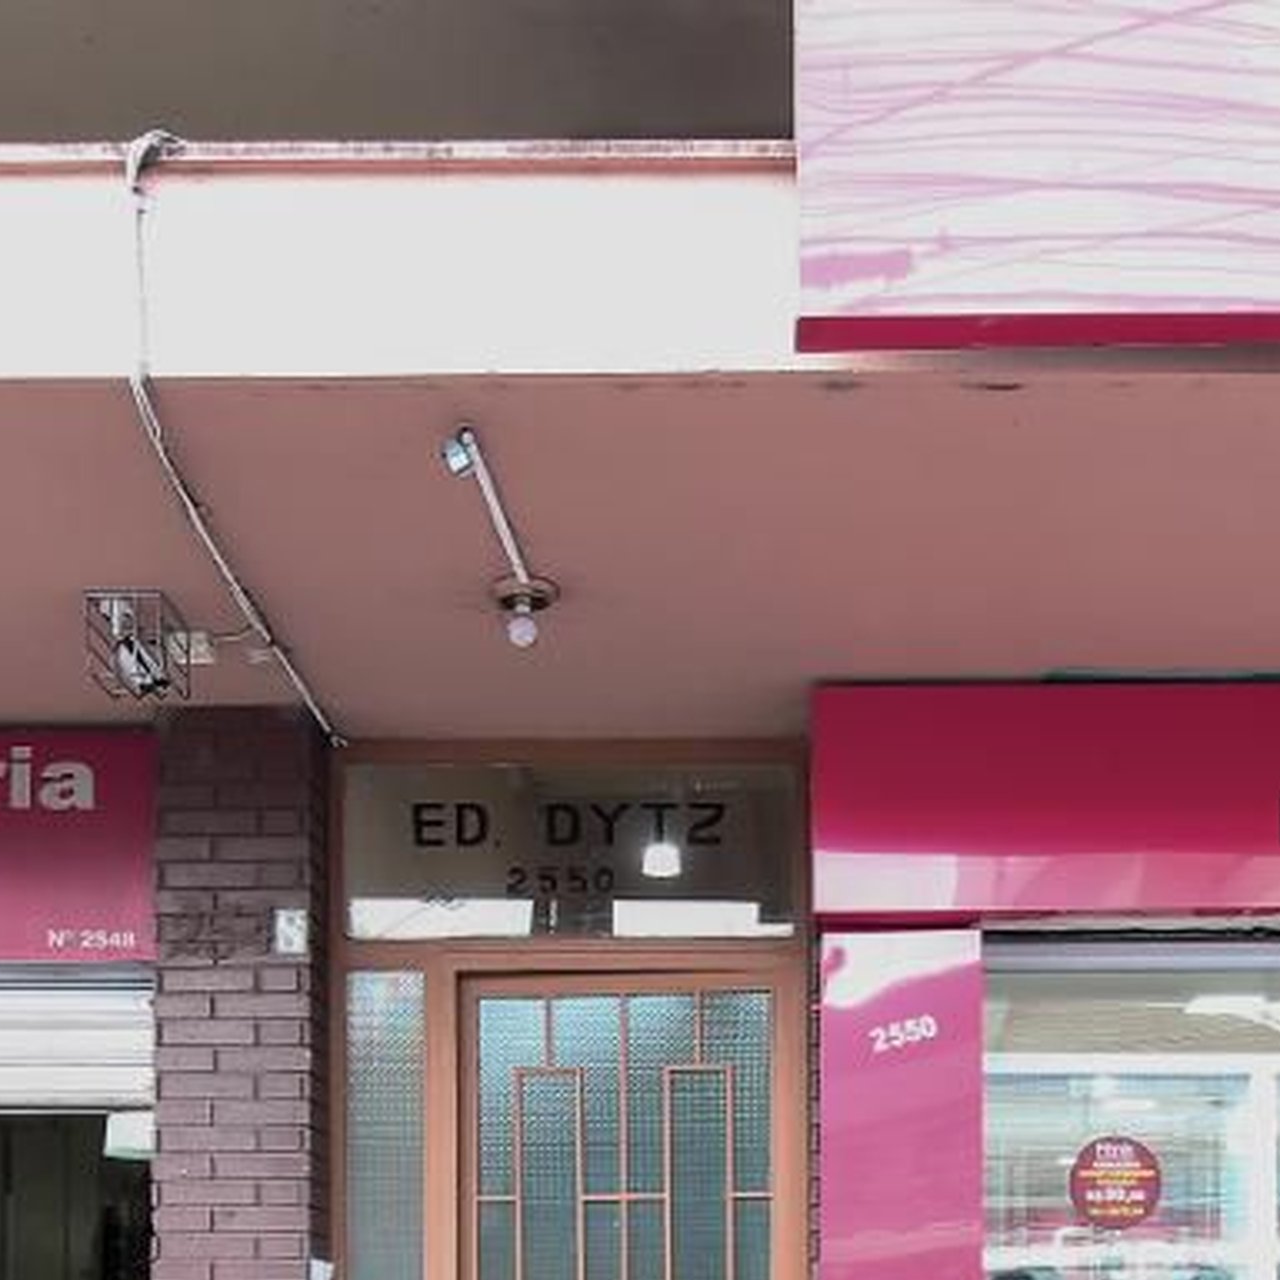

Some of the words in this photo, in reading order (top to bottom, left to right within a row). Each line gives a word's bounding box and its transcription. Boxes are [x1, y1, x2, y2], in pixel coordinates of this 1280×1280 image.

[411, 802, 502, 849] ED.
[546, 801, 726, 848] DYTZ
[505, 866, 615, 897] 2550
[868, 1014, 939, 1054] 2550
